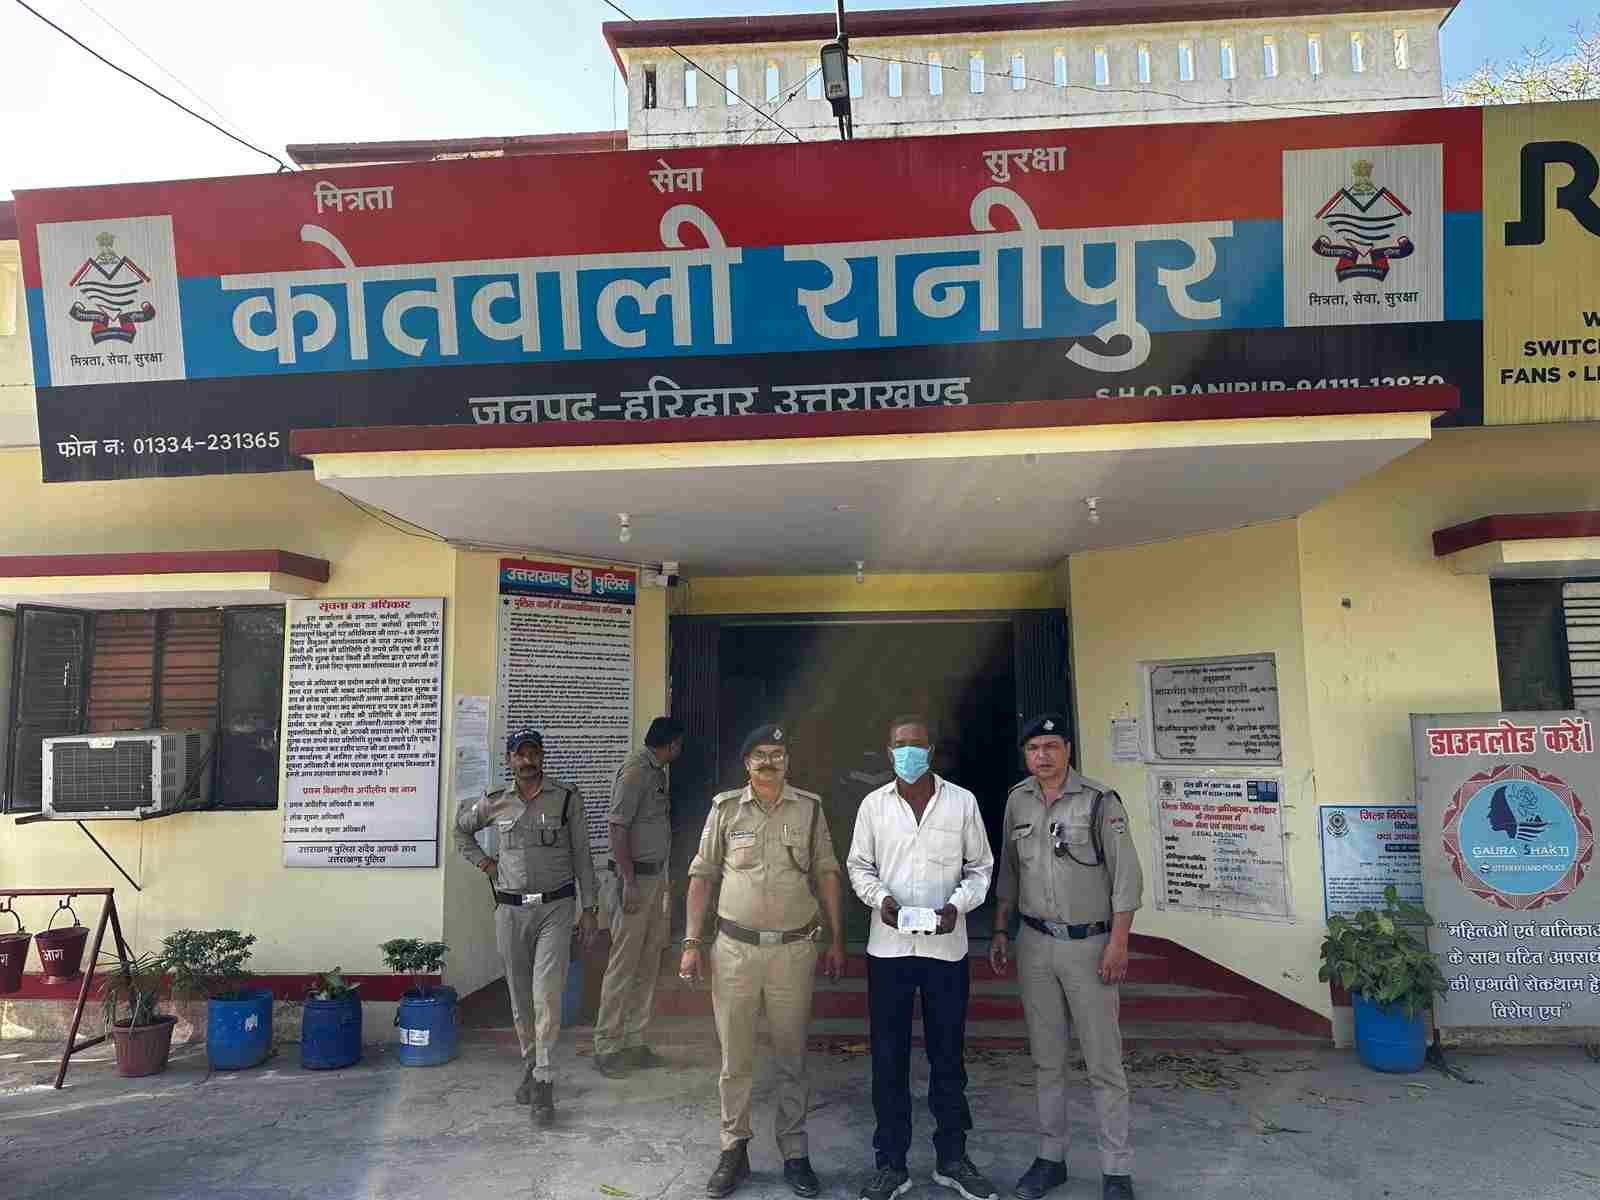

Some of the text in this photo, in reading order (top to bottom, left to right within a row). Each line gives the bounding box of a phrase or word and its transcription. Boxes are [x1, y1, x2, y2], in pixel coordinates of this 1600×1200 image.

[983, 147, 1067, 183] सुरक्षा
[649, 159, 703, 193] सेवा
[314, 181, 394, 213] मित्रता
[221, 186, 1233, 372] कोतवाली रानीपुर
[1384, 292, 1419, 307] सुरक्षा
[1524, 339, 1600, 357] SWITC
[1501, 367, 1561, 385] FANS
[772, 377, 971, 414] उत्तराखण्ड
[57, 435, 97, 458] फोन
[133, 431, 280, 454] 01334-231365
[506, 567, 570, 587] उत्तराखण्ड
[595, 573, 631, 594] पुलिस
[320, 602, 348, 613] सूचना
[370, 599, 410, 609] अधिकार
[1427, 719, 1537, 756] डाउनलोड
[1472, 844, 1569, 858] GAURA SHAKTI
[1513, 920, 1535, 939] एवं
[1448, 947, 1464, 964] के
[1468, 951, 1500, 965] साथ
[1504, 946, 1544, 965] घटित
[1448, 973, 1469, 992] की
[1474, 973, 1520, 994] प्रभावी
[1523, 974, 1584, 993] रोकथाम
[1490, 1000, 1535, 1018] विशेष
